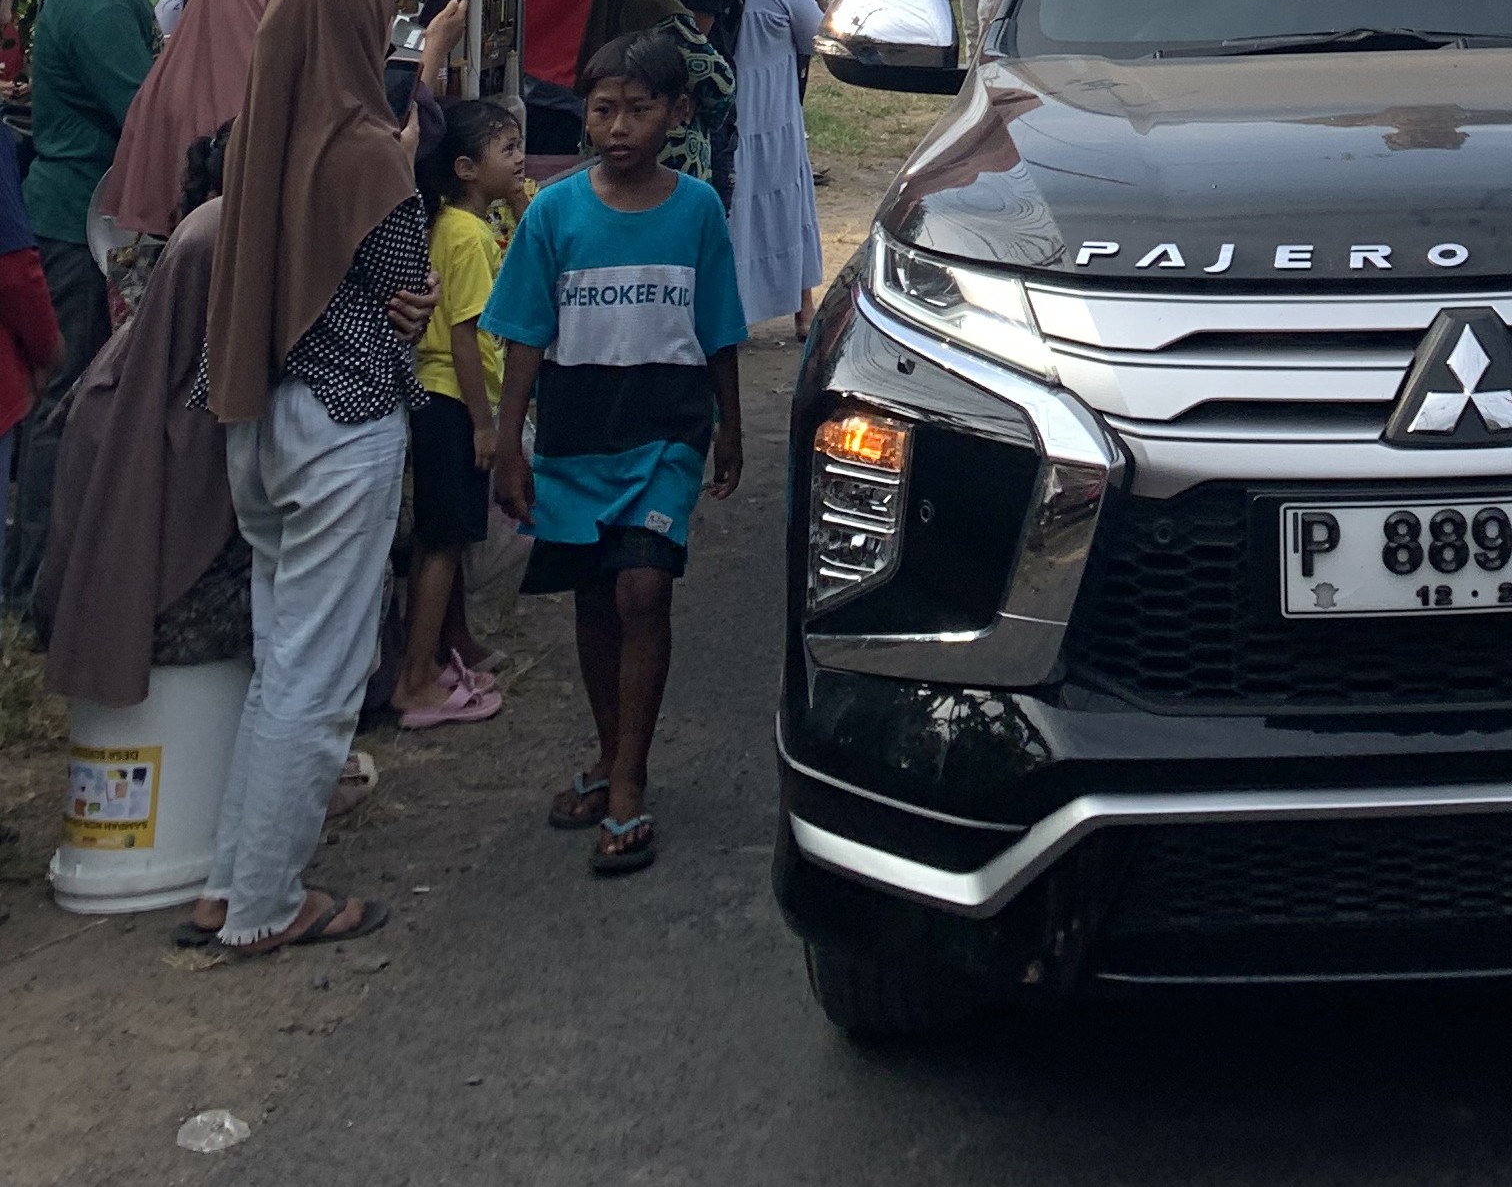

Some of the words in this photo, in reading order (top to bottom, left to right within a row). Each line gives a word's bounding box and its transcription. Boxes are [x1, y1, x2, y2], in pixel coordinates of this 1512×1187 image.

[1074, 240, 1469, 274] PAJERO
[560, 283, 658, 307] CHEROKEE
[1300, 512, 1341, 577] P
